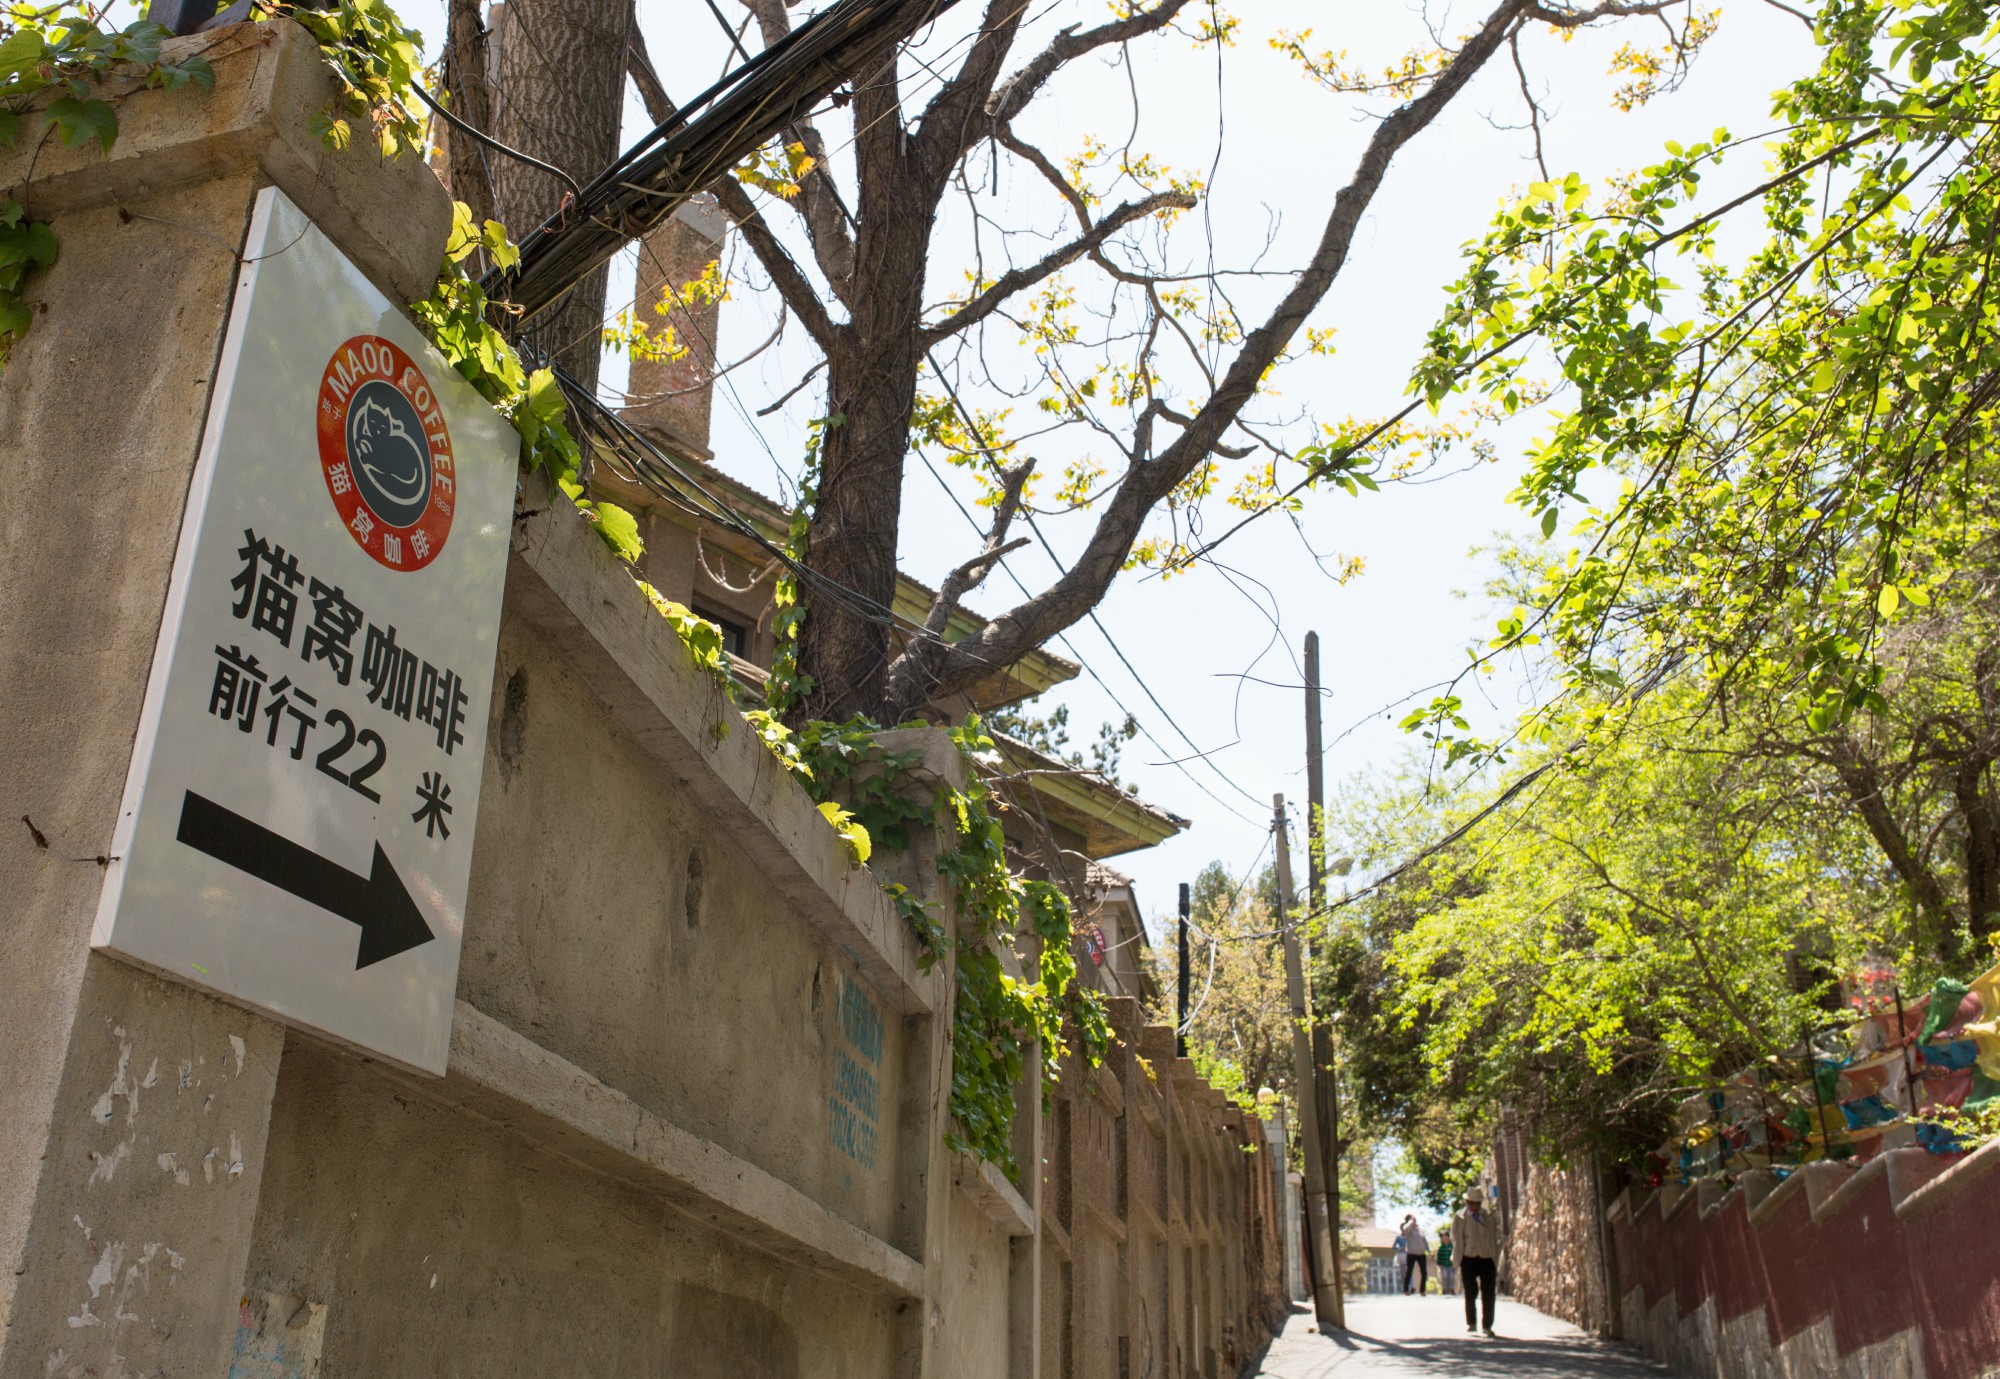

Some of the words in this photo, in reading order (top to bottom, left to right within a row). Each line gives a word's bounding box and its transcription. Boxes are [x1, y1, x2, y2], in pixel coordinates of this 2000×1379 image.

[327, 342, 394, 403] MAOO
[402, 366, 453, 494] COFFEE
[328, 461, 429, 564] 猫窝咖啡
[231, 528, 468, 756] 猫窝咖啡
